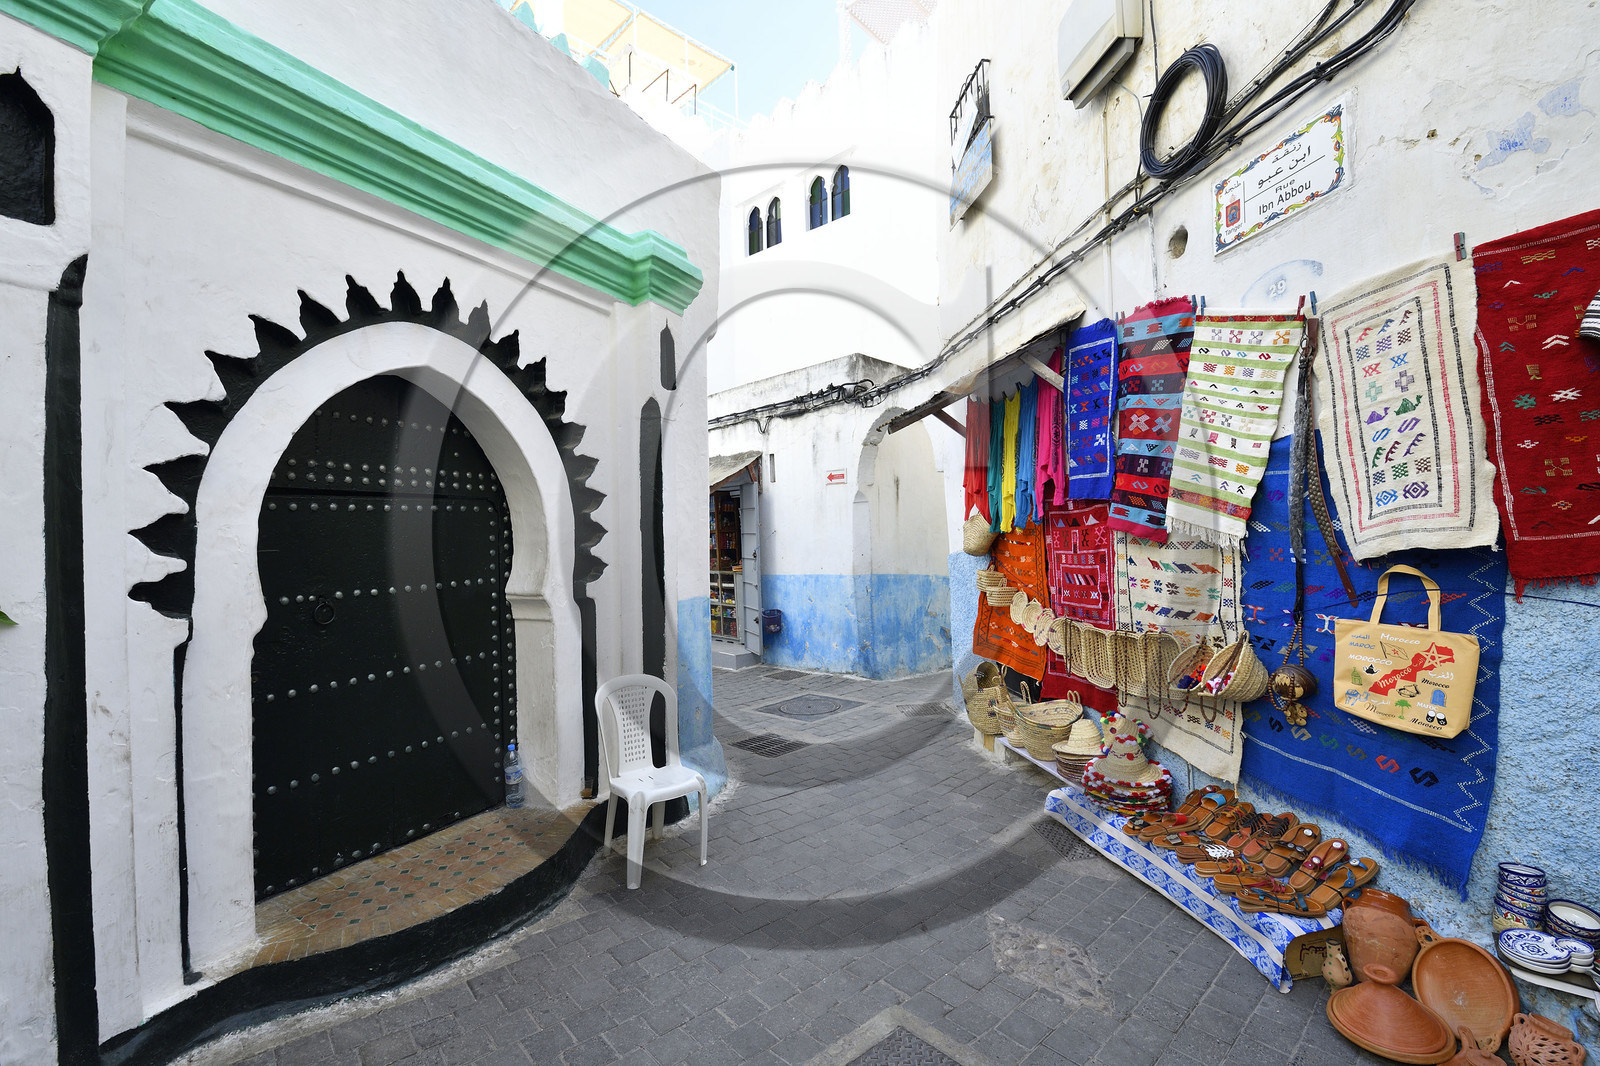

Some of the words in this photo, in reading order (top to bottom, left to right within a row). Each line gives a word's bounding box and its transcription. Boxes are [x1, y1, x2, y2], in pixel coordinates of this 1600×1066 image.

[1272, 143, 1302, 164] زنقة
[1289, 145, 1311, 170] ابن
[1258, 167, 1284, 189] عبو
[1275, 179, 1296, 194] Rue
[1258, 201, 1274, 216] Ibn
[1277, 180, 1311, 206] Abbou
[1225, 222, 1243, 236] Tanger
[1268, 280, 1286, 298] 29
[1348, 641, 1376, 650] MAROC
[1380, 633, 1421, 645] Morocco
[1348, 653, 1393, 666] MOROCCO
[1377, 667, 1412, 688] Morocco
[1421, 678, 1450, 689] Morocco
[1410, 718, 1443, 731] Morocco
